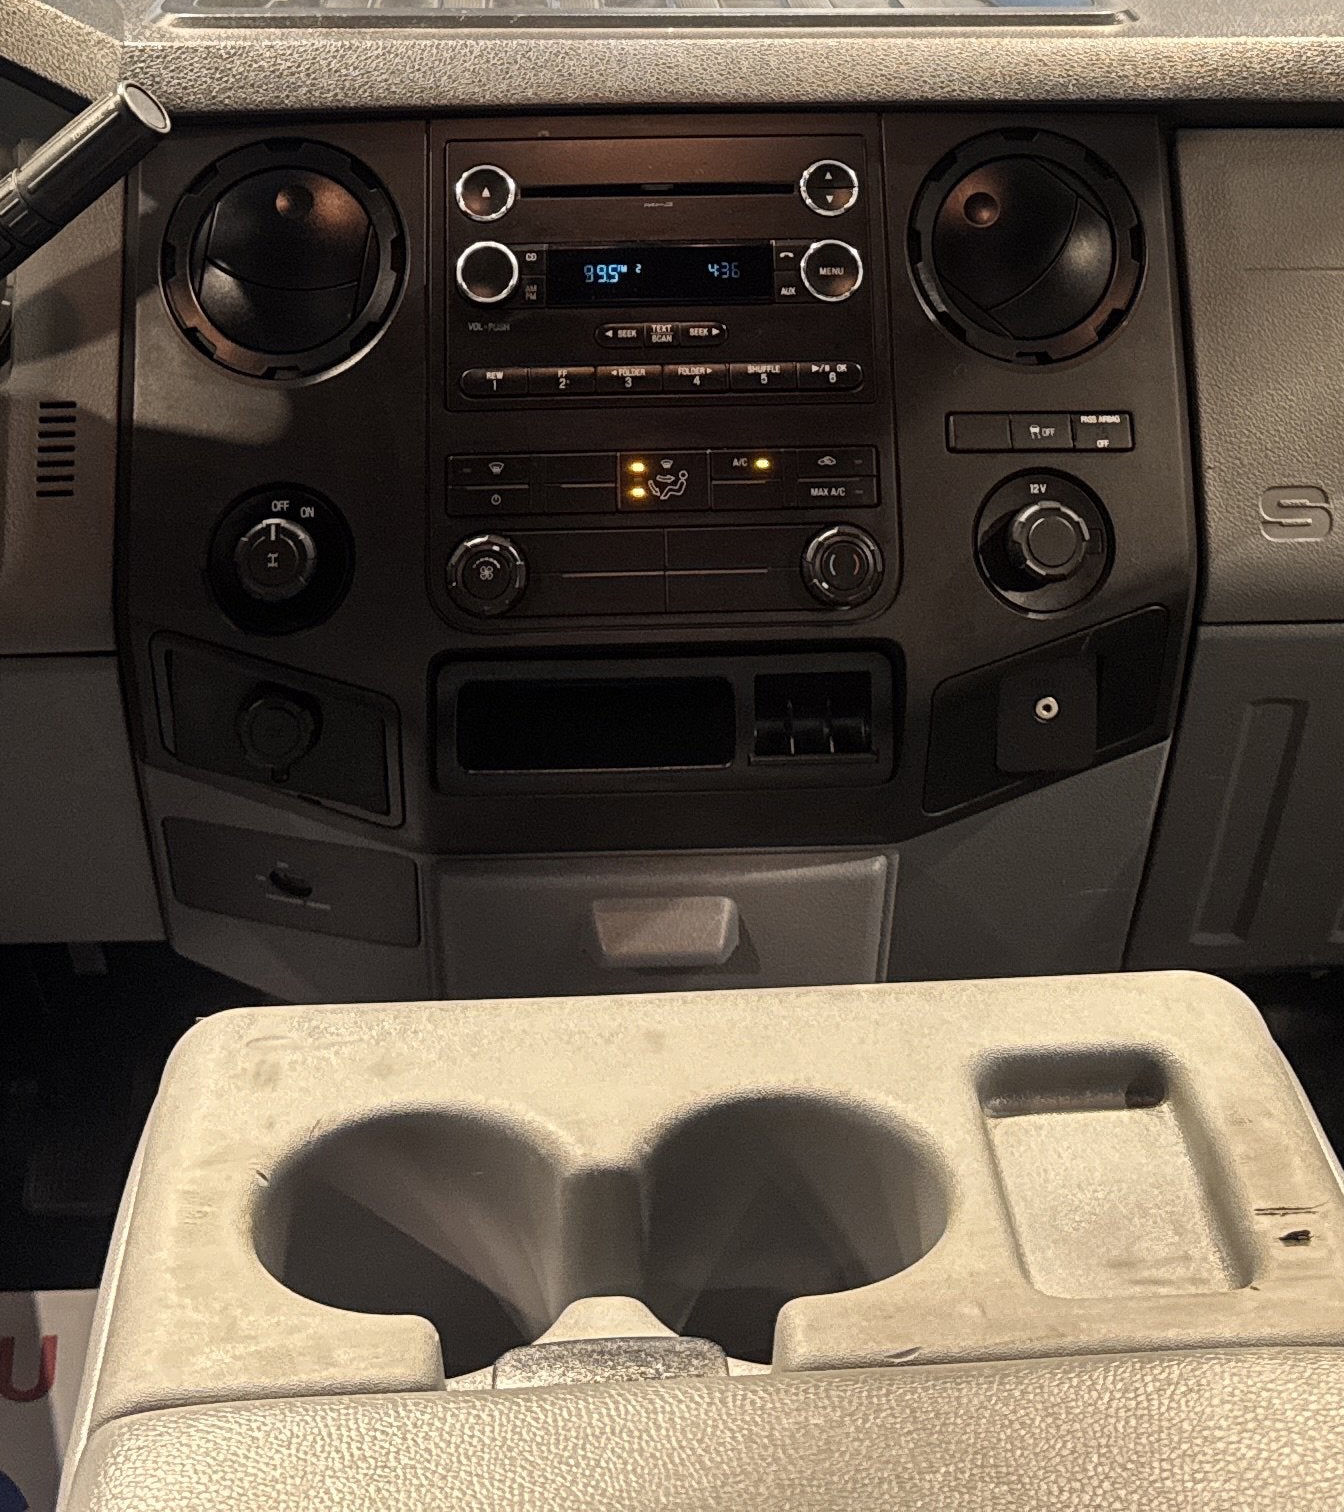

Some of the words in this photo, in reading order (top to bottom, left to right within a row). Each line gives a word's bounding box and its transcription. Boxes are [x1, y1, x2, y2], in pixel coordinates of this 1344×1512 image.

[525, 252, 538, 262] CD
[819, 266, 845, 277] MENU
[780, 286, 796, 296] AUX
[617, 329, 637, 339] SEEK
[651, 324, 672, 333] TEXT
[689, 327, 709, 337] SEEK
[624, 377, 632, 388] 3
[693, 375, 701, 386] 4
[760, 373, 768, 384] 5
[829, 372, 837, 383] 6
[492, 380, 498, 391] 1
[558, 378, 566, 389] 2
[1042, 428, 1055, 437] OFF
[1096, 439, 1109, 448] OFF
[732, 457, 748, 468] A/C
[810, 487, 829, 497] MAX
[830, 486, 846, 497] A/C
[271, 500, 290, 513] OFF
[300, 506, 315, 519] ON
